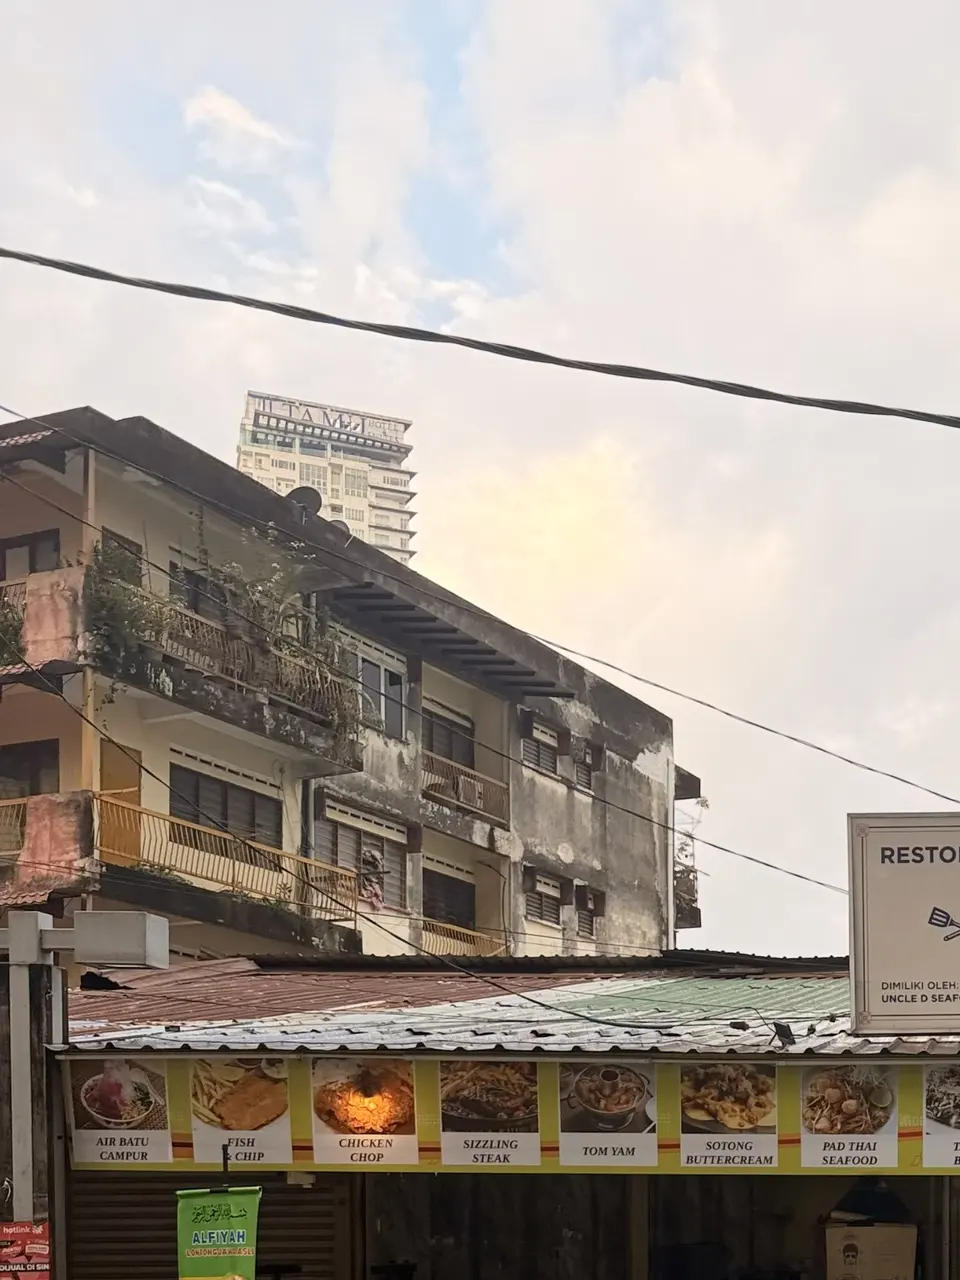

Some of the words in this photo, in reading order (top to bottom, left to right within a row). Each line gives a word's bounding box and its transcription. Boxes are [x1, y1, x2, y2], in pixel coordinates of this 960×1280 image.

[881, 981, 924, 991] DIMILIKI
[926, 980, 959, 990] OLEH:
[881, 994, 918, 1004] UNCLE
[920, 993, 929, 1003] D
[95, 1136, 116, 1147] AIR
[119, 1137, 149, 1147] BATU
[227, 1137, 256, 1148] FISH
[338, 1138, 394, 1149] CHICKEN
[463, 1139, 519, 1150] SIZZLING
[705, 1141, 753, 1151] SOTONG
[822, 1141, 846, 1152] PAD
[848, 1141, 877, 1152] THAI
[99, 1150, 148, 1161] CAMPUR
[234, 1151, 265, 1162] CHIP
[582, 1146, 609, 1156] TOM
[611, 1146, 636, 1157] YAM
[349, 1152, 384, 1163] CHOP
[471, 1153, 511, 1164] STEAK
[685, 1155, 774, 1165] BUTTERCREAM
[821, 1155, 878, 1166] SEAFOOD
[3, 1226, 31, 1234] hotlink
[192, 1230, 246, 1245] ALFIYAH
[186, 1248, 217, 1257] LONTONG
[27, 1263, 35, 1271] DI
